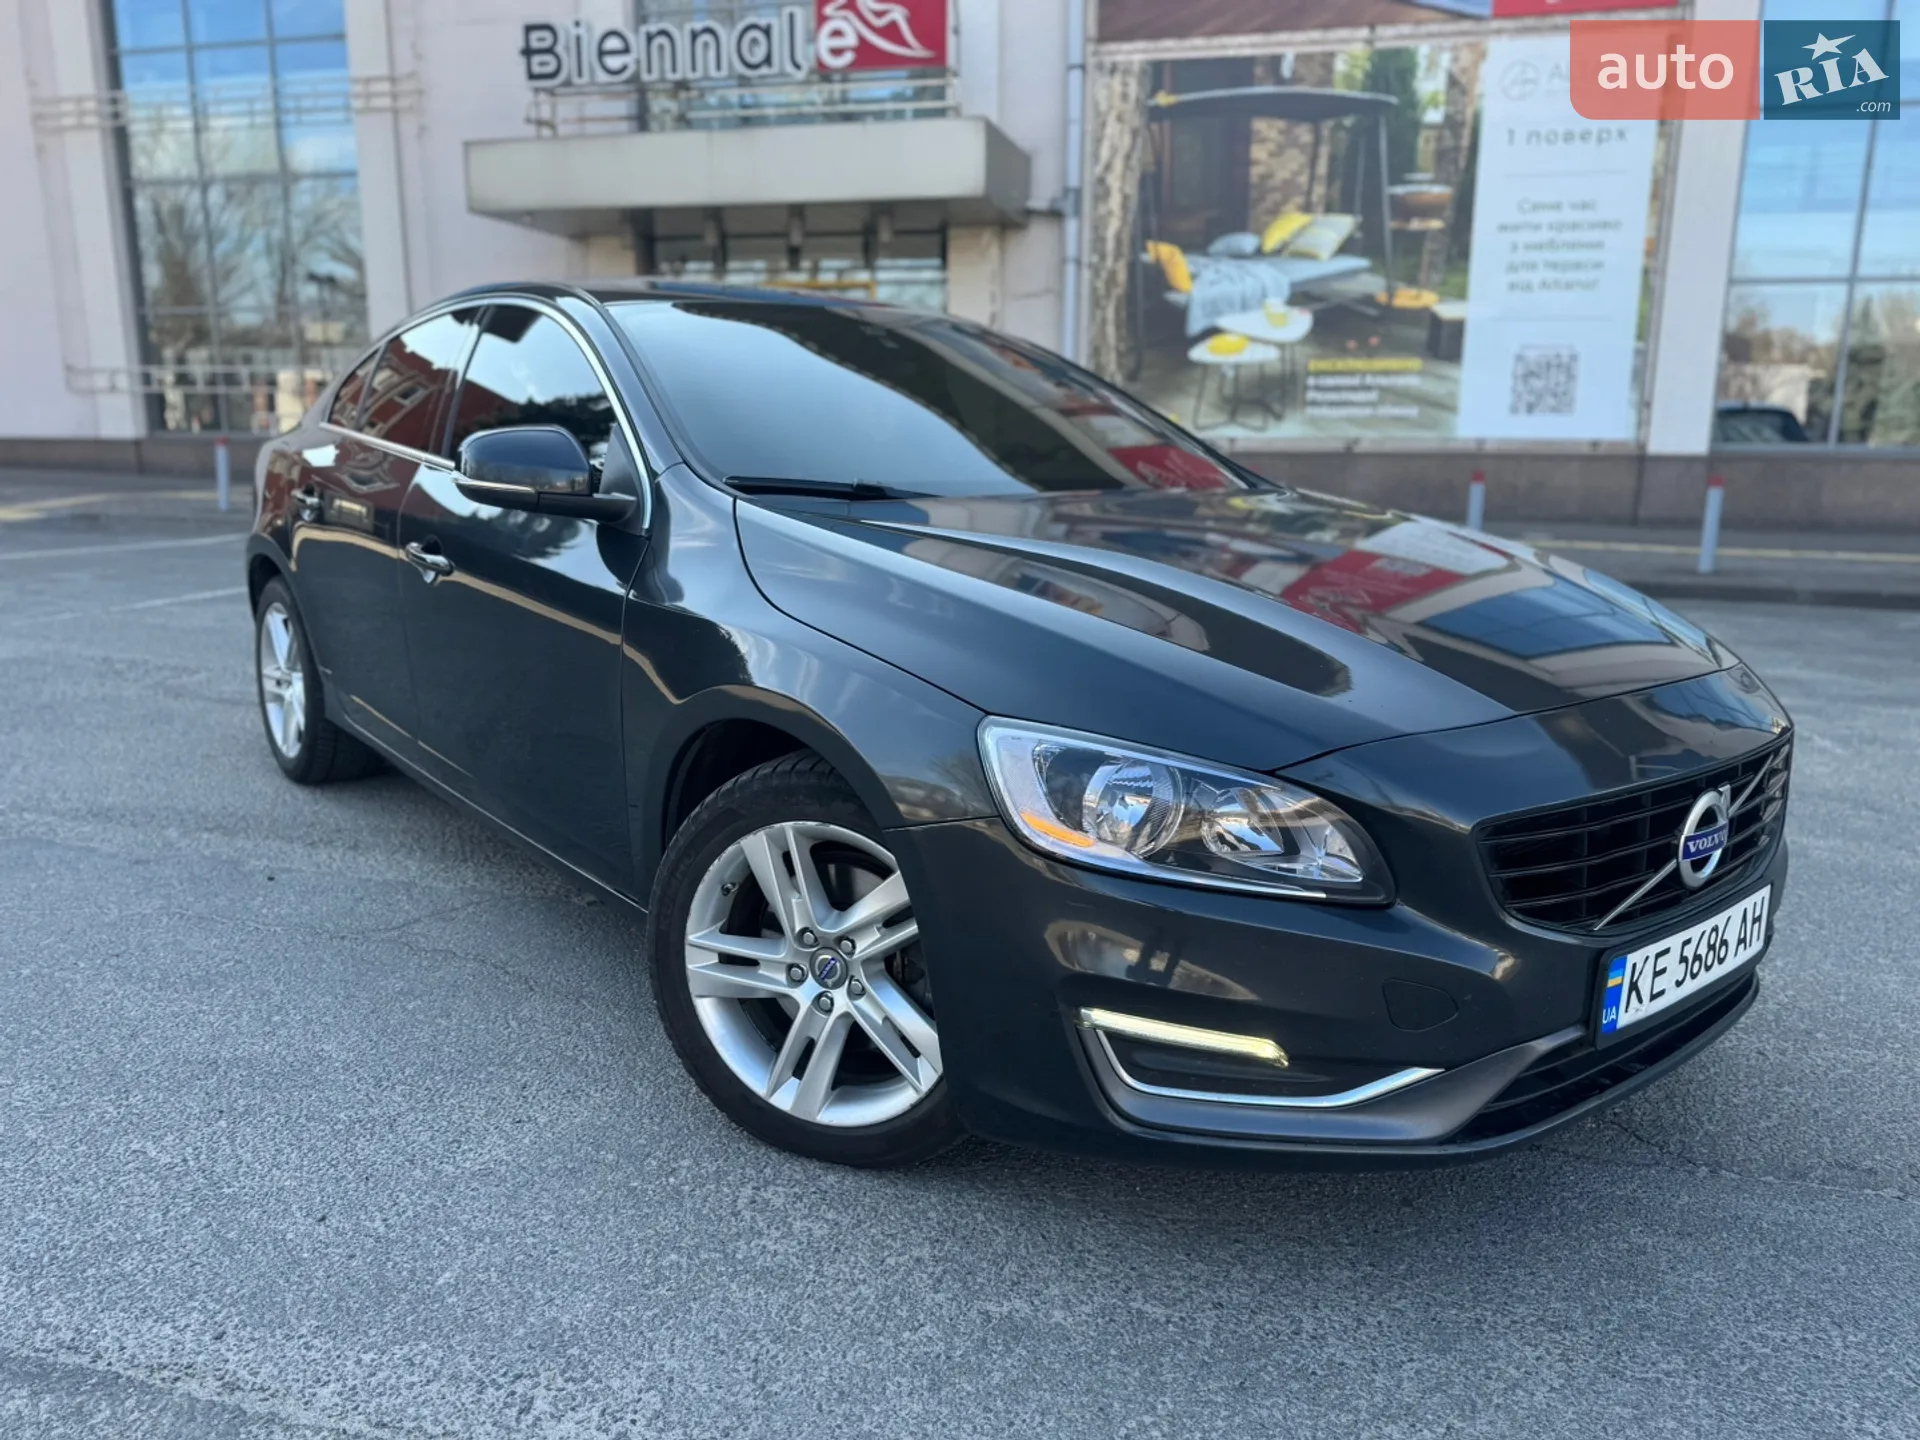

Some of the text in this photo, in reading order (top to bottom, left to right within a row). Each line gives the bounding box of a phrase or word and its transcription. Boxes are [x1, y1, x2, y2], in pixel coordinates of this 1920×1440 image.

[520, 8, 859, 84] Biennale
[1525, 126, 1629, 147] поверх
[1624, 897, 1765, 1014] KE 5686 AH
[1602, 1006, 1617, 1024] UA
